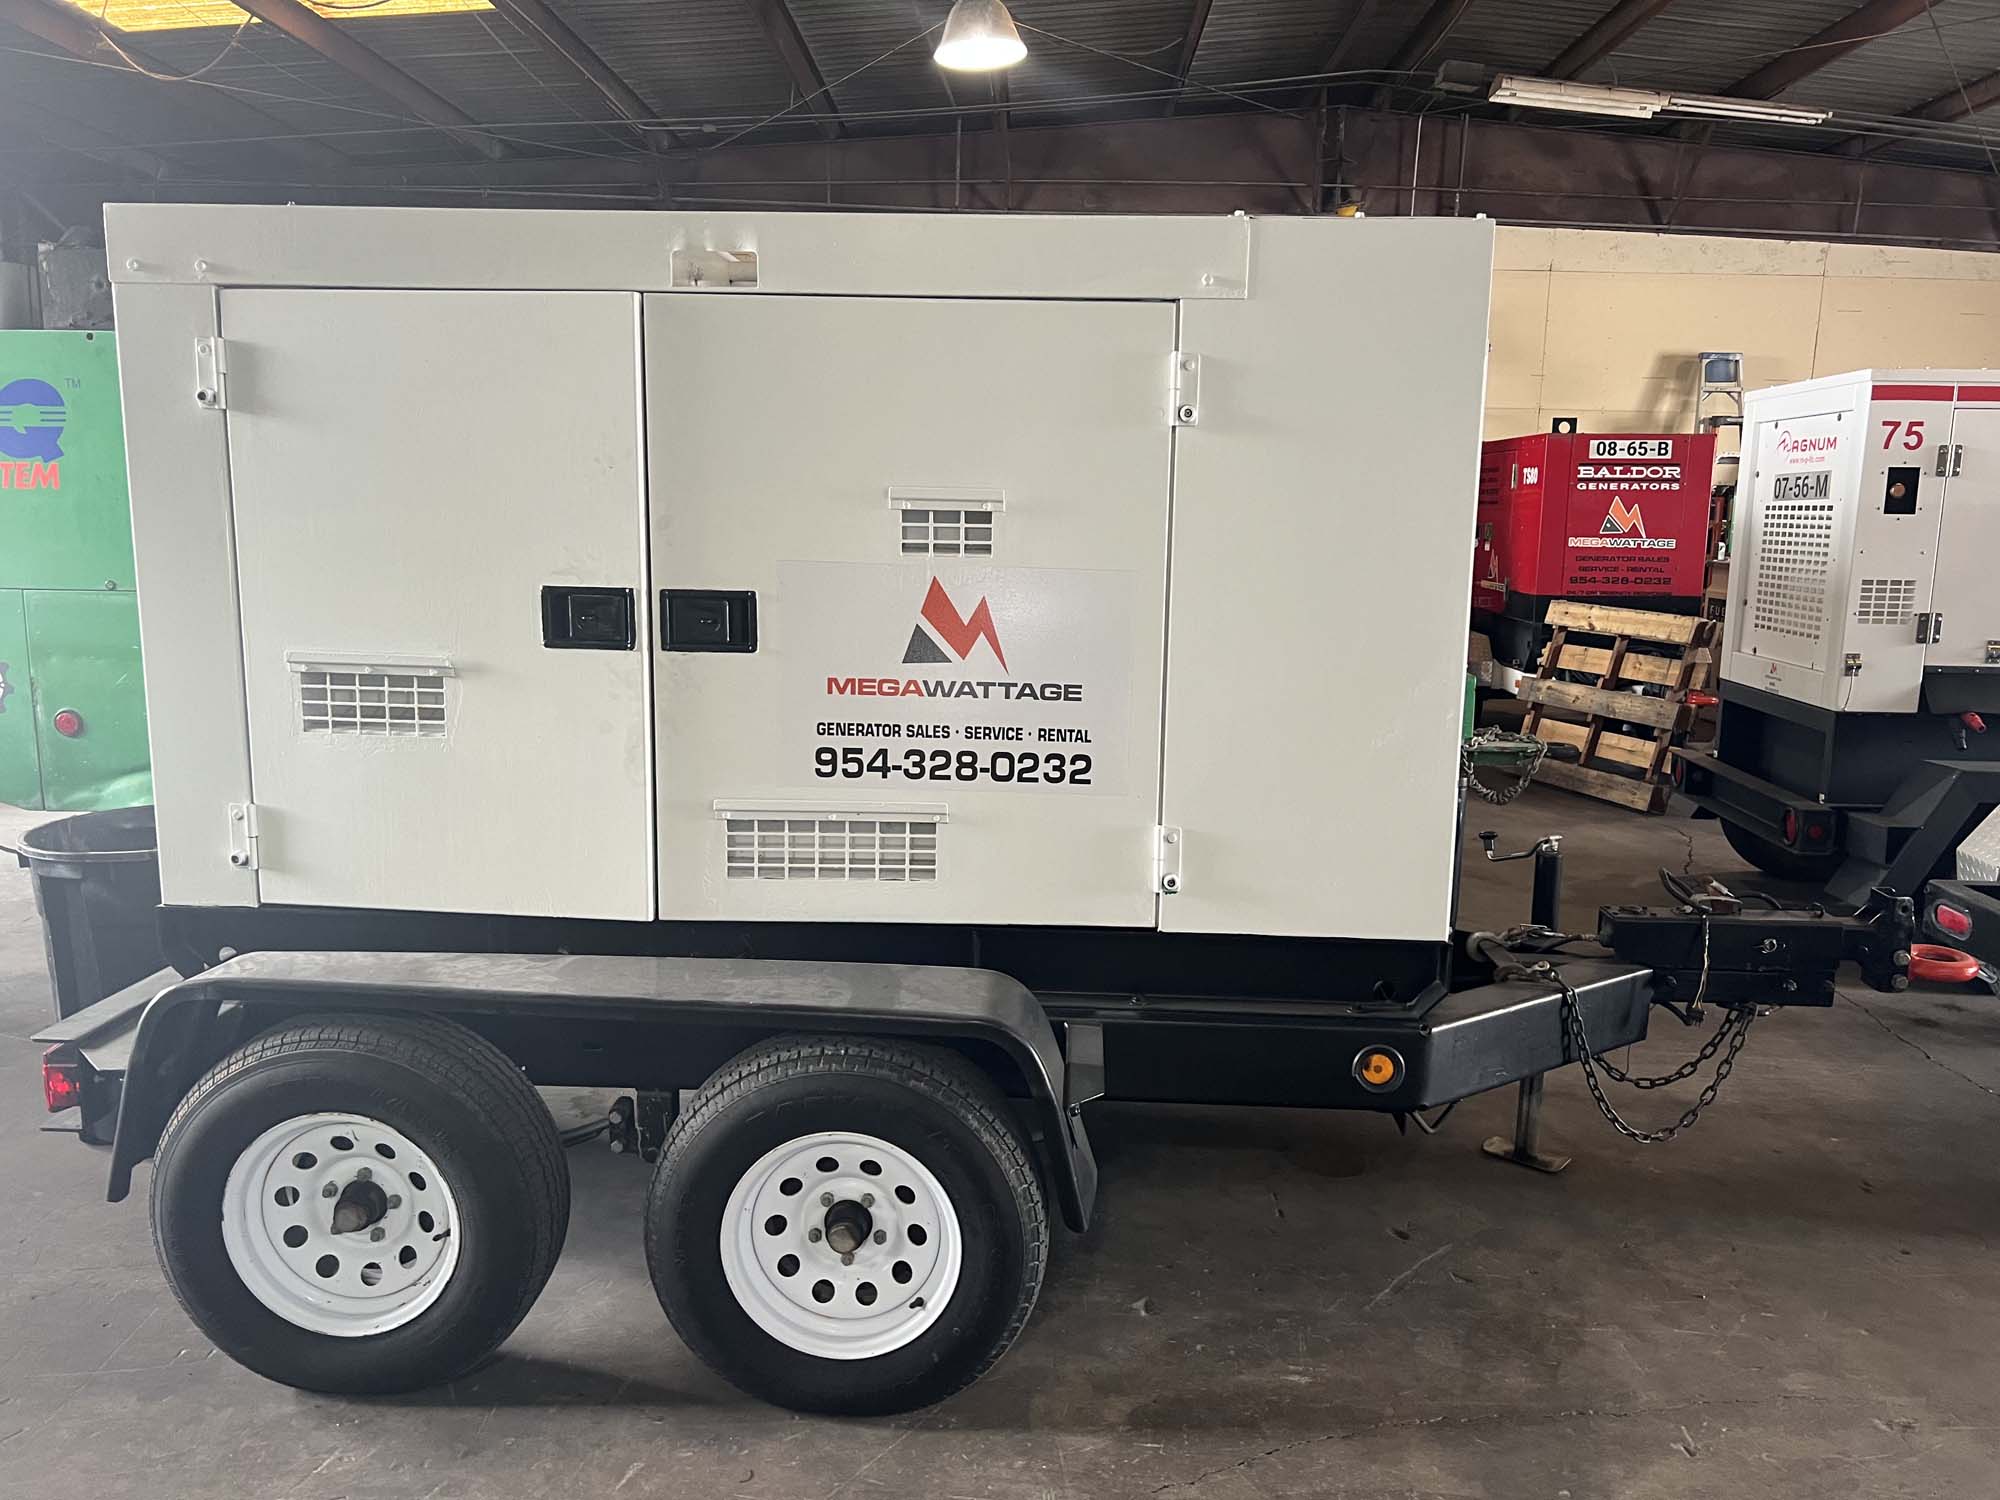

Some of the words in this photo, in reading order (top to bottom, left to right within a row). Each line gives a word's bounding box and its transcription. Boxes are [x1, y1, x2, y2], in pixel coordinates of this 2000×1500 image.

[64, 377, 81, 389] TM
[1881, 420, 1925, 450] 75
[1596, 441, 1669, 457] 08-65-B
[1577, 466, 1681, 479] BALDOR
[1577, 482, 1680, 491] GENERATORS
[1774, 474, 1829, 499] 07-56-M
[1568, 537, 1676, 549] MEGAWATTAGE
[1569, 576, 1672, 585] 954-328-0232
[827, 677, 1083, 702] MEGAWATTAGE
[816, 722, 901, 738] GENERATOR
[906, 724, 951, 739] SALES
[964, 726, 1024, 741] SERVICE
[1037, 728, 1092, 743] RENTAL
[814, 747, 1092, 785] 954-328-0232
